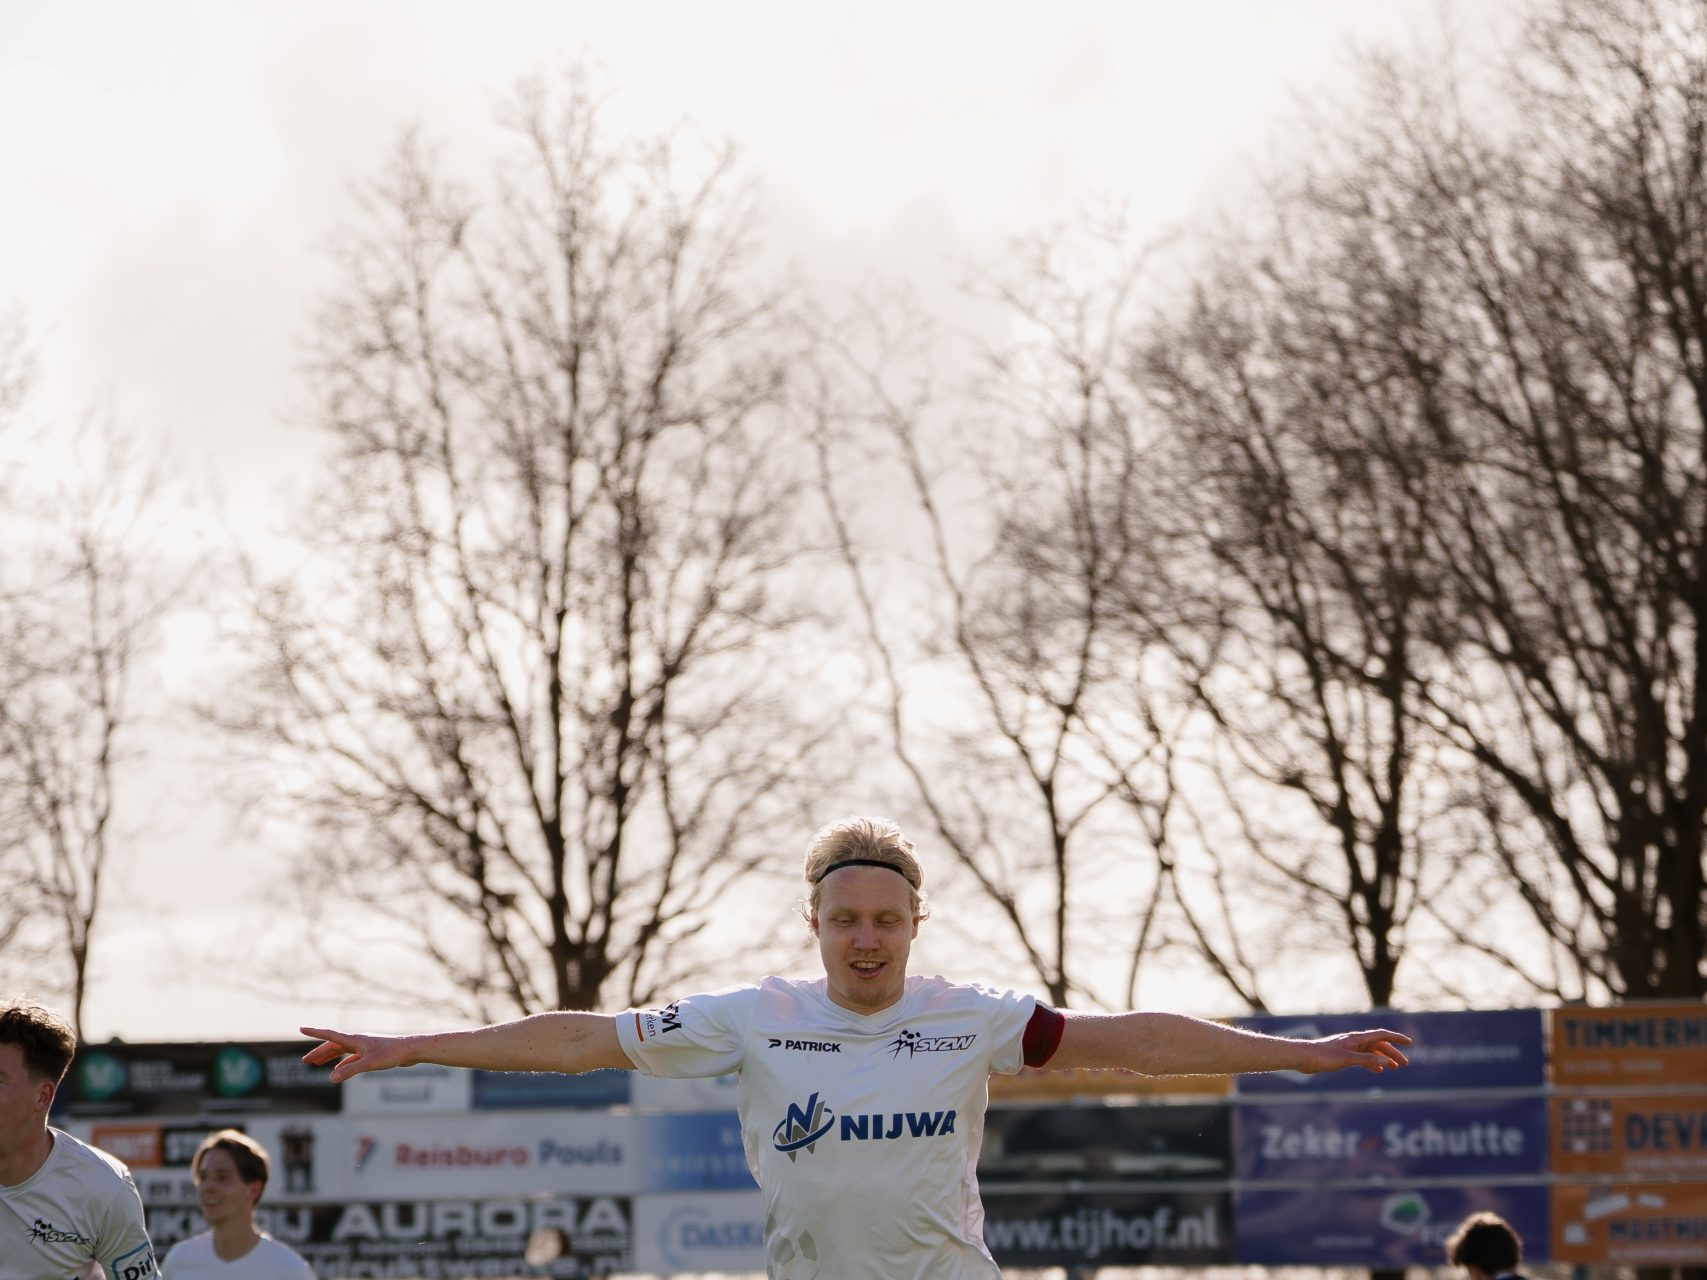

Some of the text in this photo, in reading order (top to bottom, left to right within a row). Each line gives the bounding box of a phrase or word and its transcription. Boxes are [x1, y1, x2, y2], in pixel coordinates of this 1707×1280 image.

[785, 1039, 841, 1052] PATRICK
[914, 1034, 977, 1052] SVZW
[841, 1109, 957, 1142] NIJWA
[1261, 1122, 1523, 1158] Zeker Schutte
[395, 1142, 529, 1168] Reisburo
[539, 1139, 622, 1165] Pouls
[331, 1202, 627, 1240] AURORA
